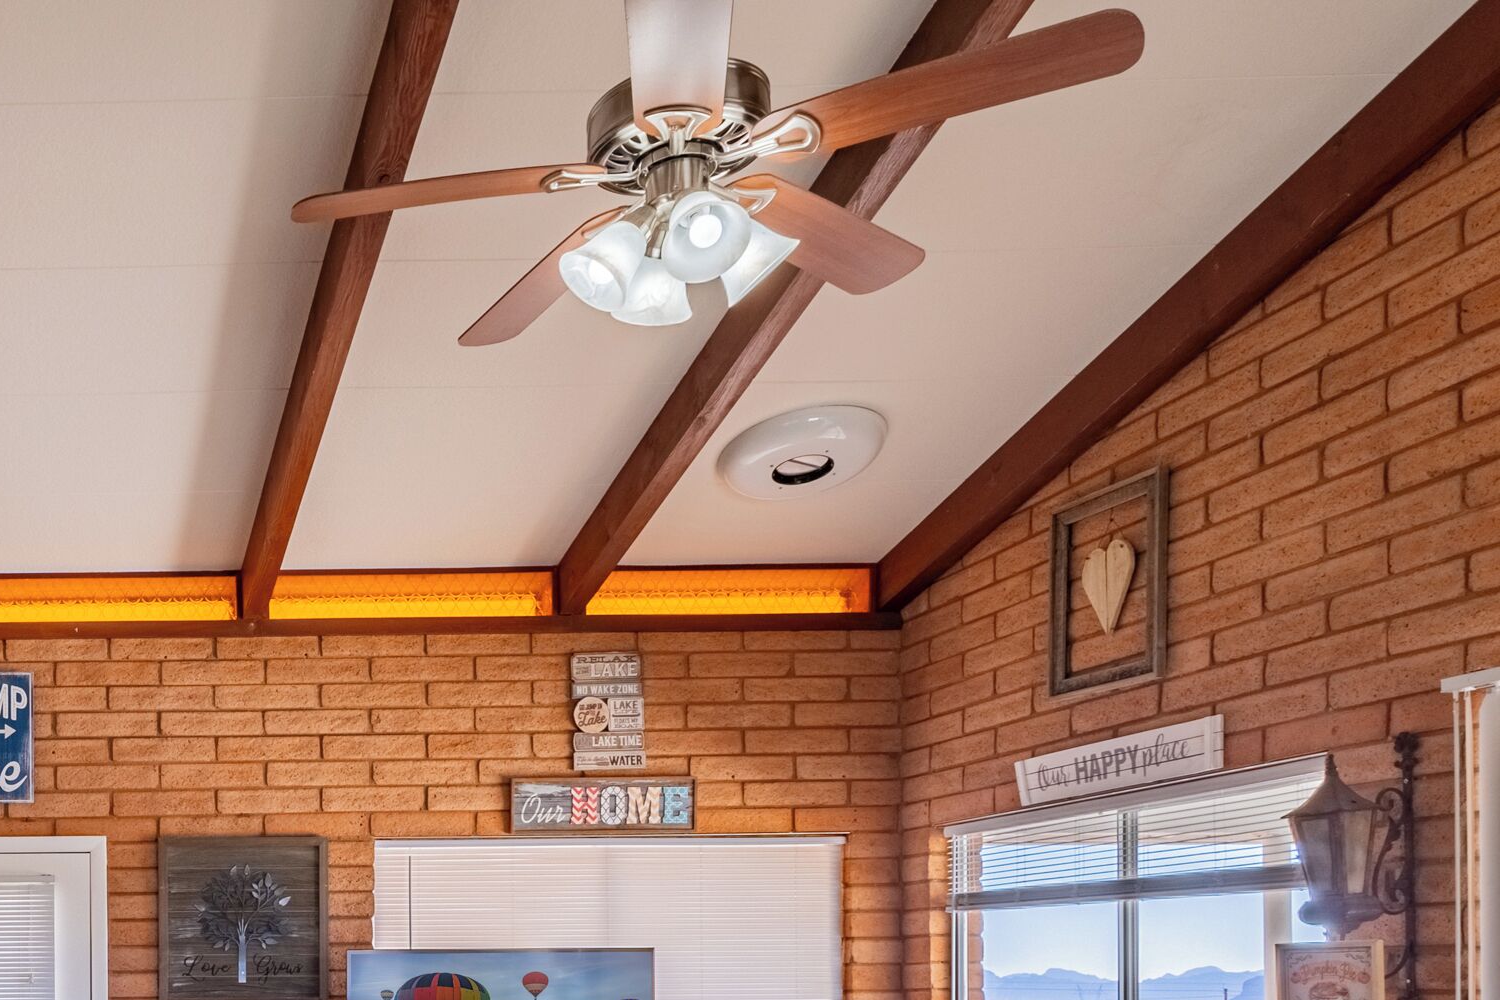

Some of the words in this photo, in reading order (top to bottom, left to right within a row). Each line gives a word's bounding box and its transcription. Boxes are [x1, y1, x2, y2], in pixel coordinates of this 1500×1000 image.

[576, 655, 636, 664] RELAX
[590, 662, 638, 677] LAKE
[576, 685, 588, 695] NO
[590, 685, 615, 694] WAKE
[617, 684, 639, 694] ZONE
[613, 700, 638, 710] LAKE
[578, 711, 607, 727] Lake
[592, 735, 617, 747] LAKE
[619, 735, 642, 746] TIME
[609, 755, 642, 766] WATER
[1038, 763, 1070, 791] Our
[1074, 744, 1139, 785] HAPPY
[1142, 733, 1189, 777] place
[520, 793, 568, 824] Our
[570, 786, 689, 825] HOME
[182, 955, 231, 982] Love
[253, 954, 303, 983] Grows
